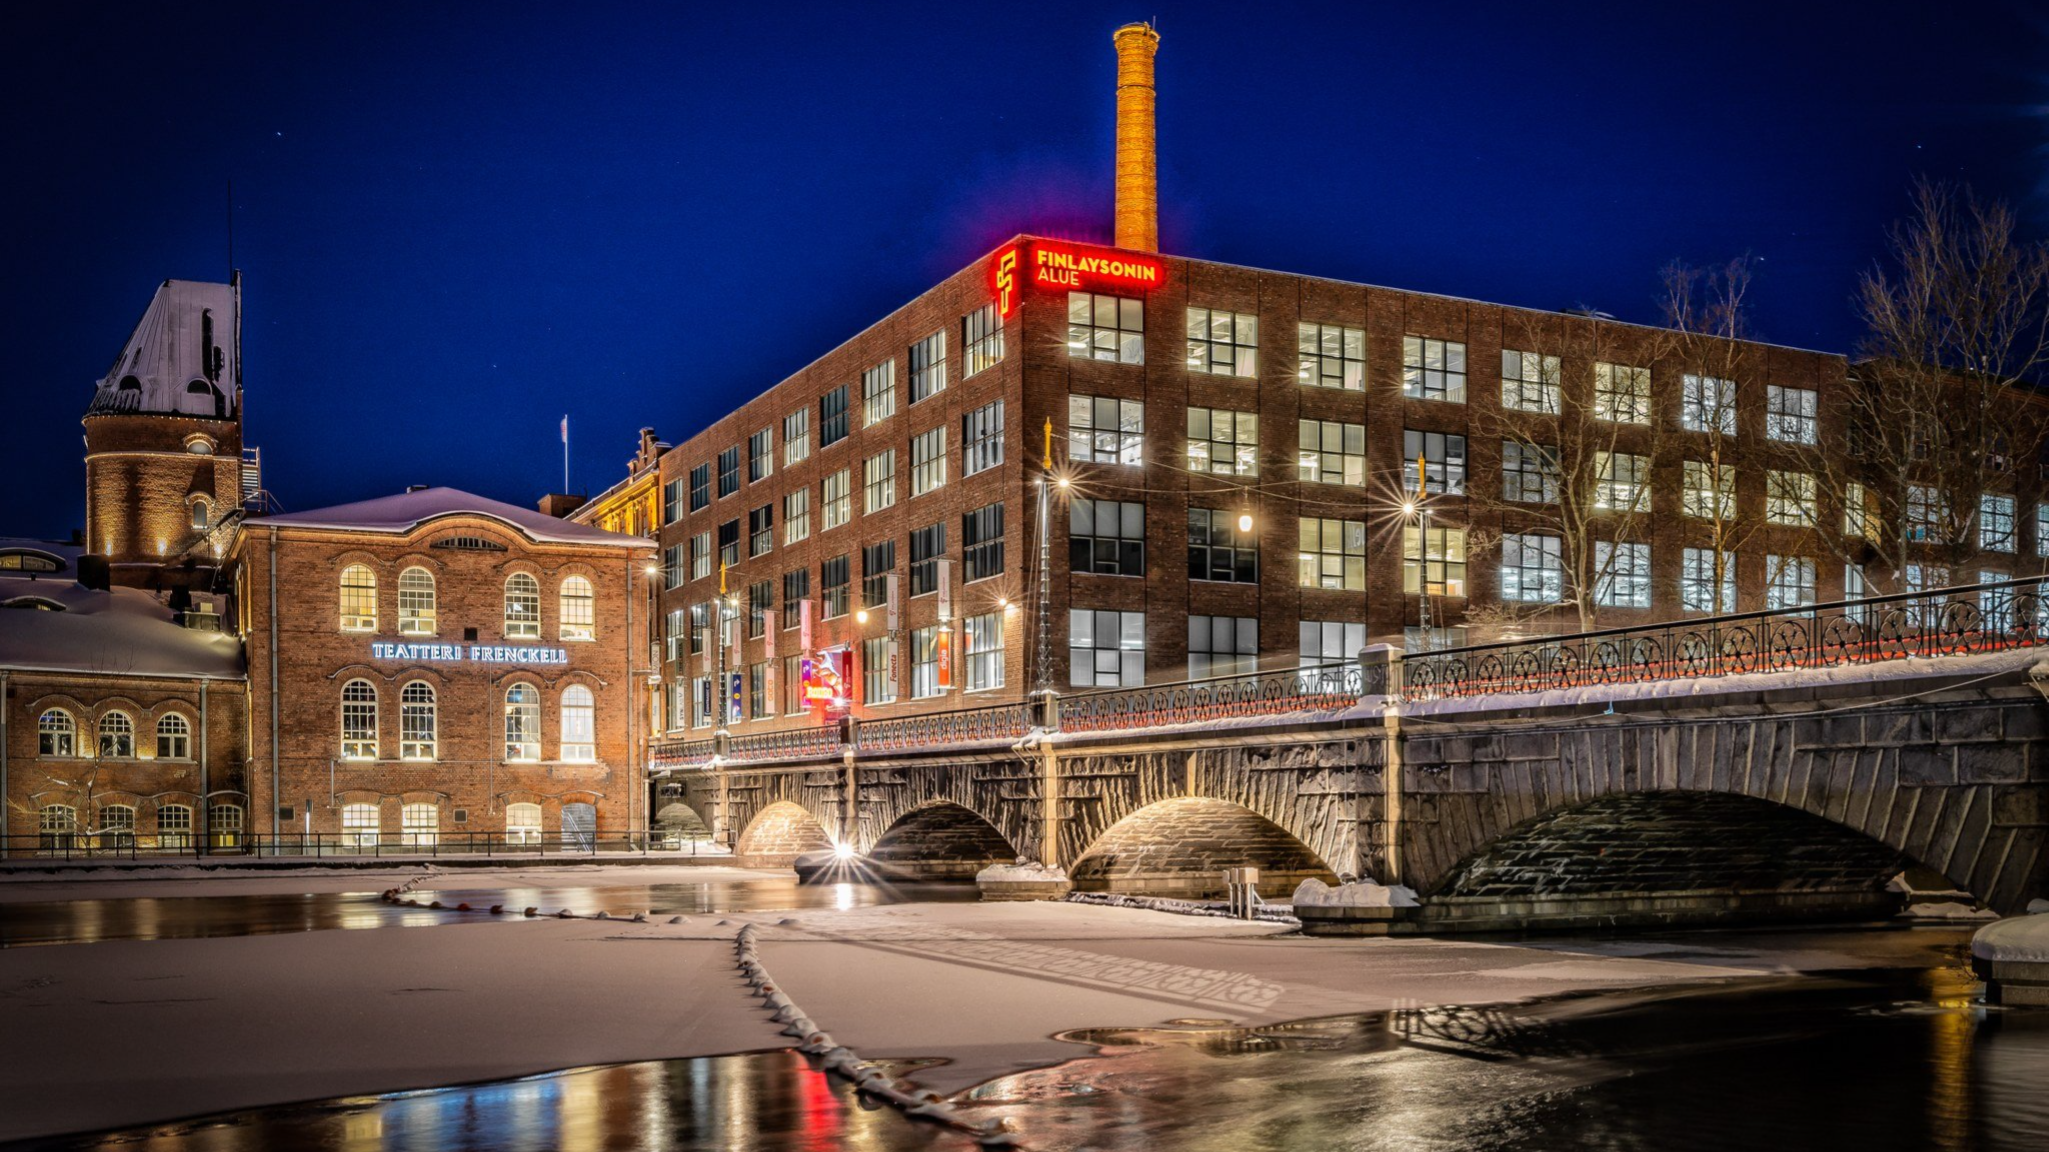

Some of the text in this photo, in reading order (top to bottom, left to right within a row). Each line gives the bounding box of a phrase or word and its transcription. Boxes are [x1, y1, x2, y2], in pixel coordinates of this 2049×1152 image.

[1037, 250, 1155, 281] FINLAYSONIN
[1037, 268, 1080, 286] ALUE
[372, 643, 568, 664] TEATTERI FRENCKELL
[940, 649, 948, 670] digia
[889, 654, 897, 682] Fonecta
